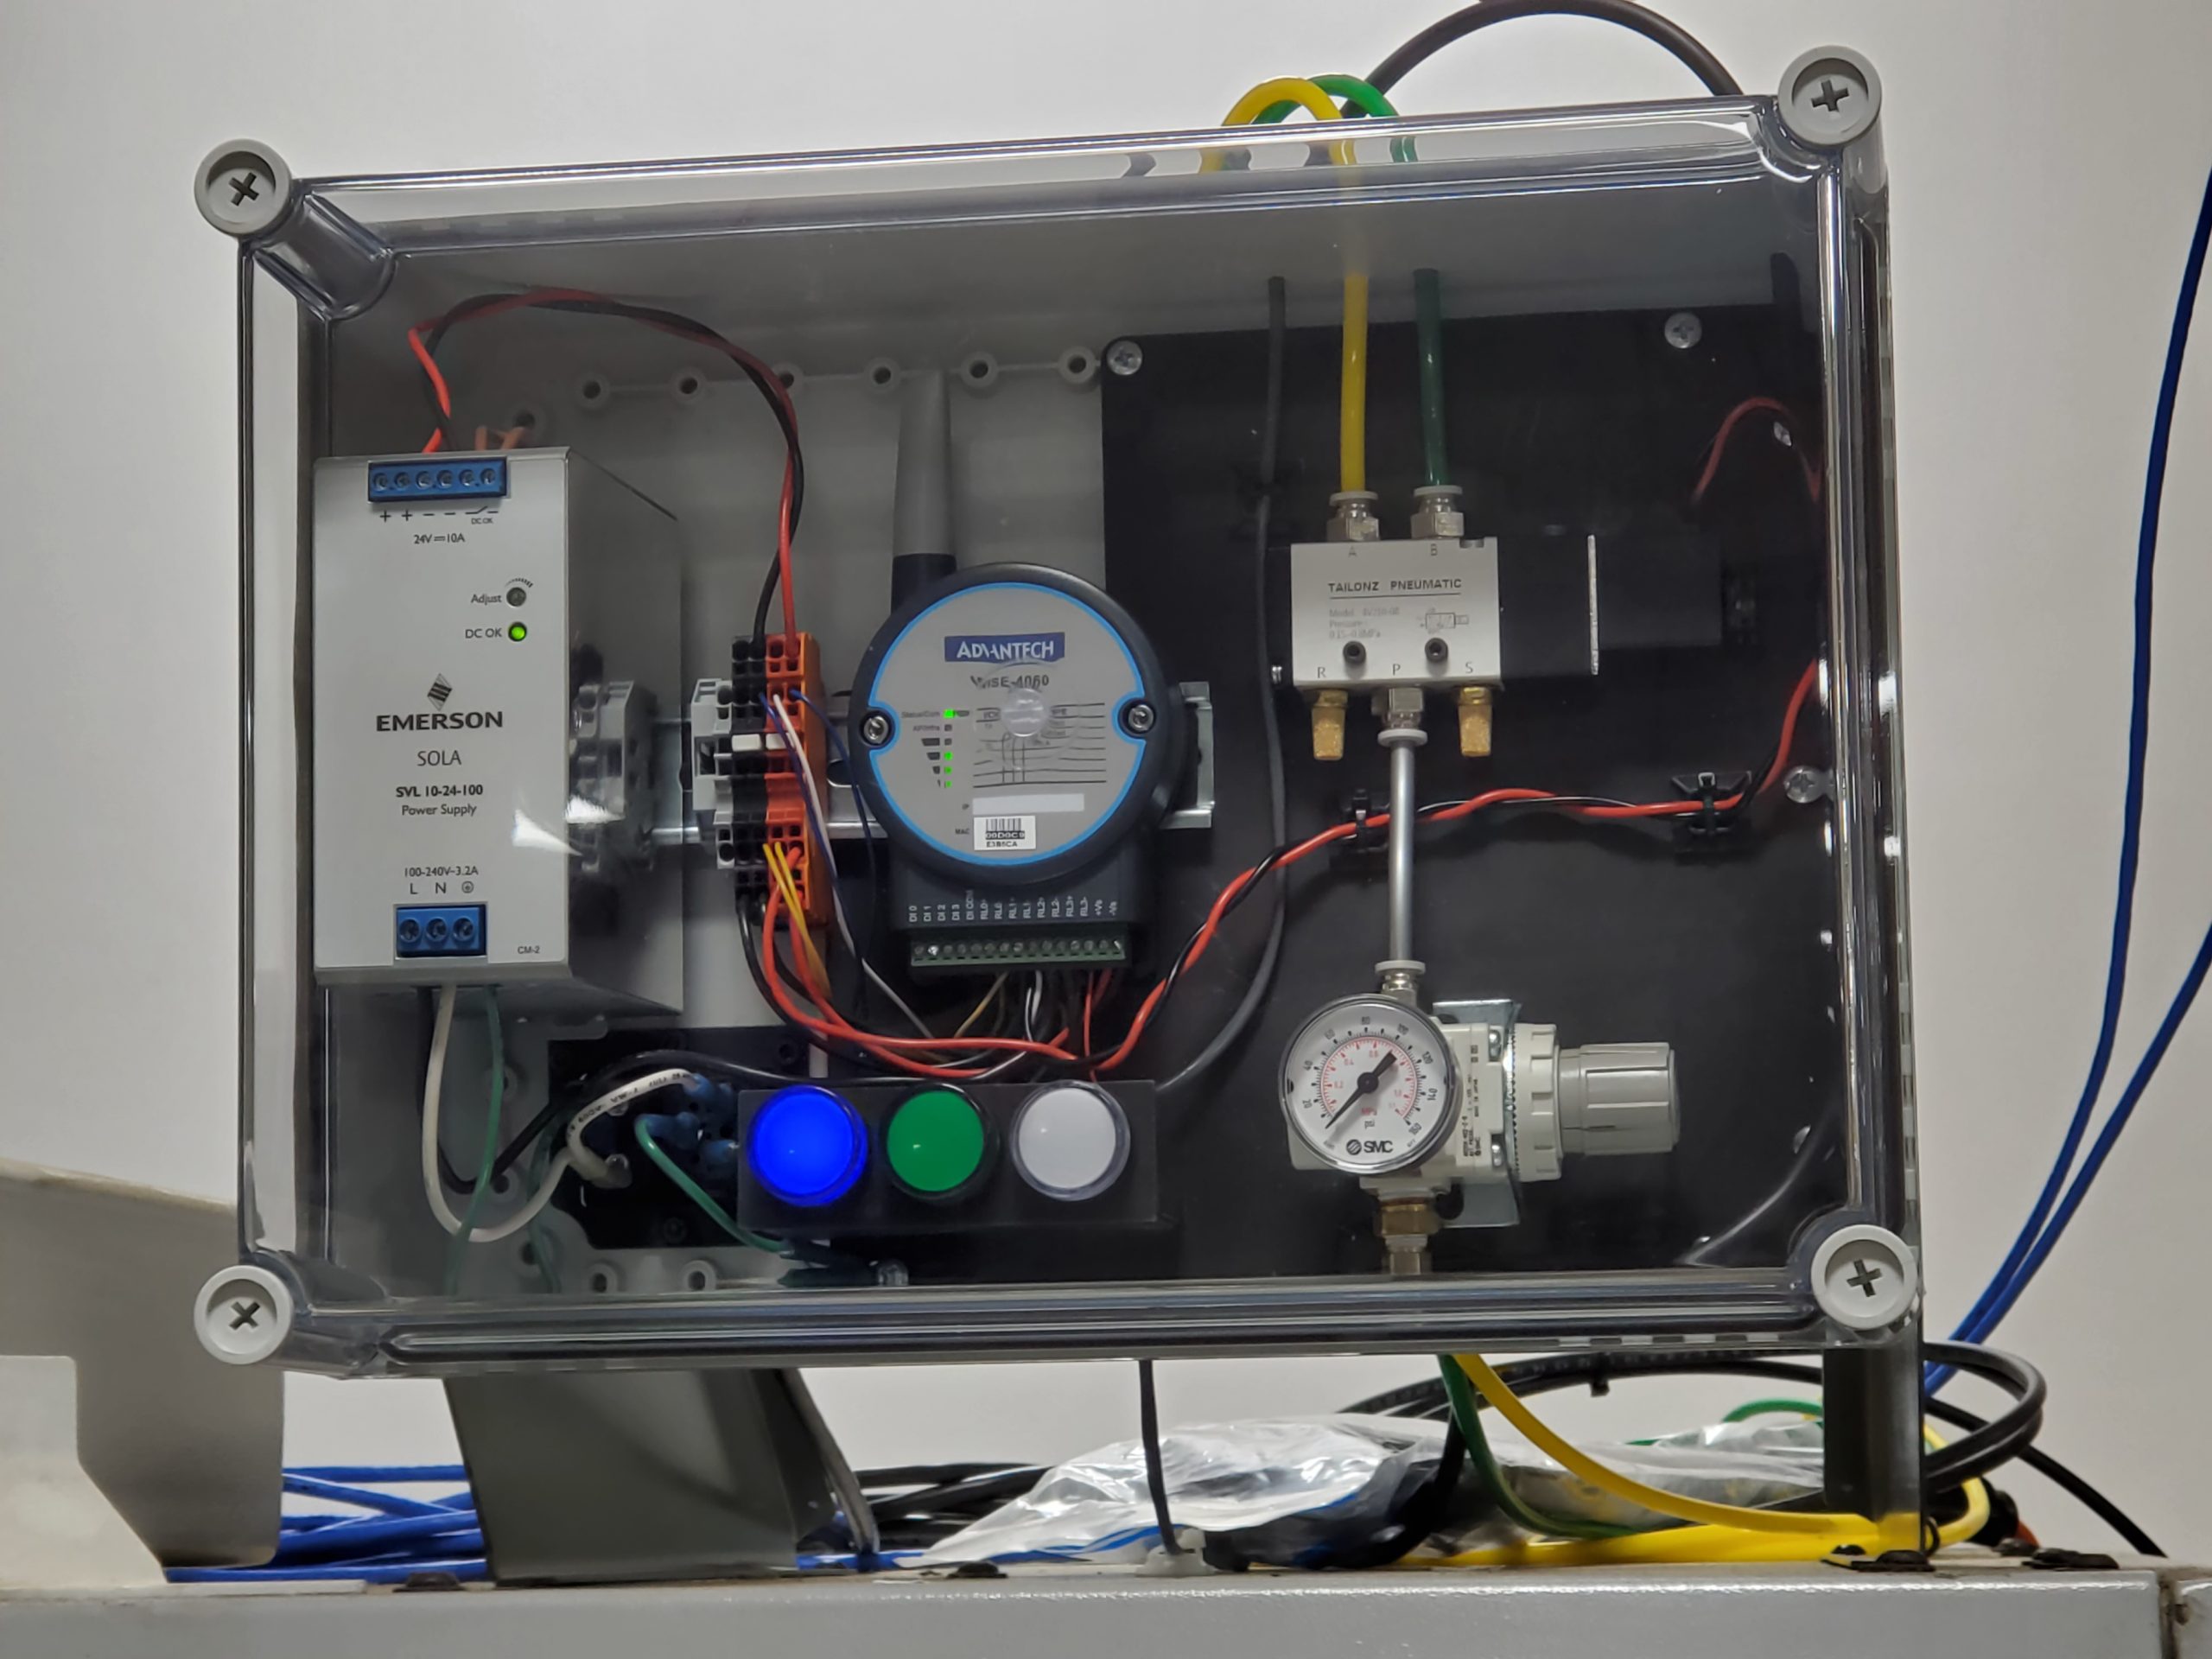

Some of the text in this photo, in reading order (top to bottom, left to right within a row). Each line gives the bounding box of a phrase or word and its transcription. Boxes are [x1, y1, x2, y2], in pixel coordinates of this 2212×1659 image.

[1348, 544, 1438, 557] A B
[1327, 578, 1463, 594] TAILONZ PNEUMATIC
[470, 593, 502, 605] Adjust
[465, 628, 503, 639] DC OK
[956, 640, 1054, 660] ADVANTECH
[1317, 662, 1473, 678] R P S
[376, 711, 504, 732] EMERSON
[416, 749, 462, 766] SOLA
[395, 784, 483, 798] SVL 10-24-100
[401, 803, 477, 817] Power Supply
[410, 882, 447, 894] L N
[518, 945, 541, 955] CM-2
[1361, 1016, 1370, 1025] 80
[1303, 1051, 1433, 1071] 40 120
[1303, 1088, 1438, 1109] 20 140
[1363, 1140, 1394, 1154] SMC
